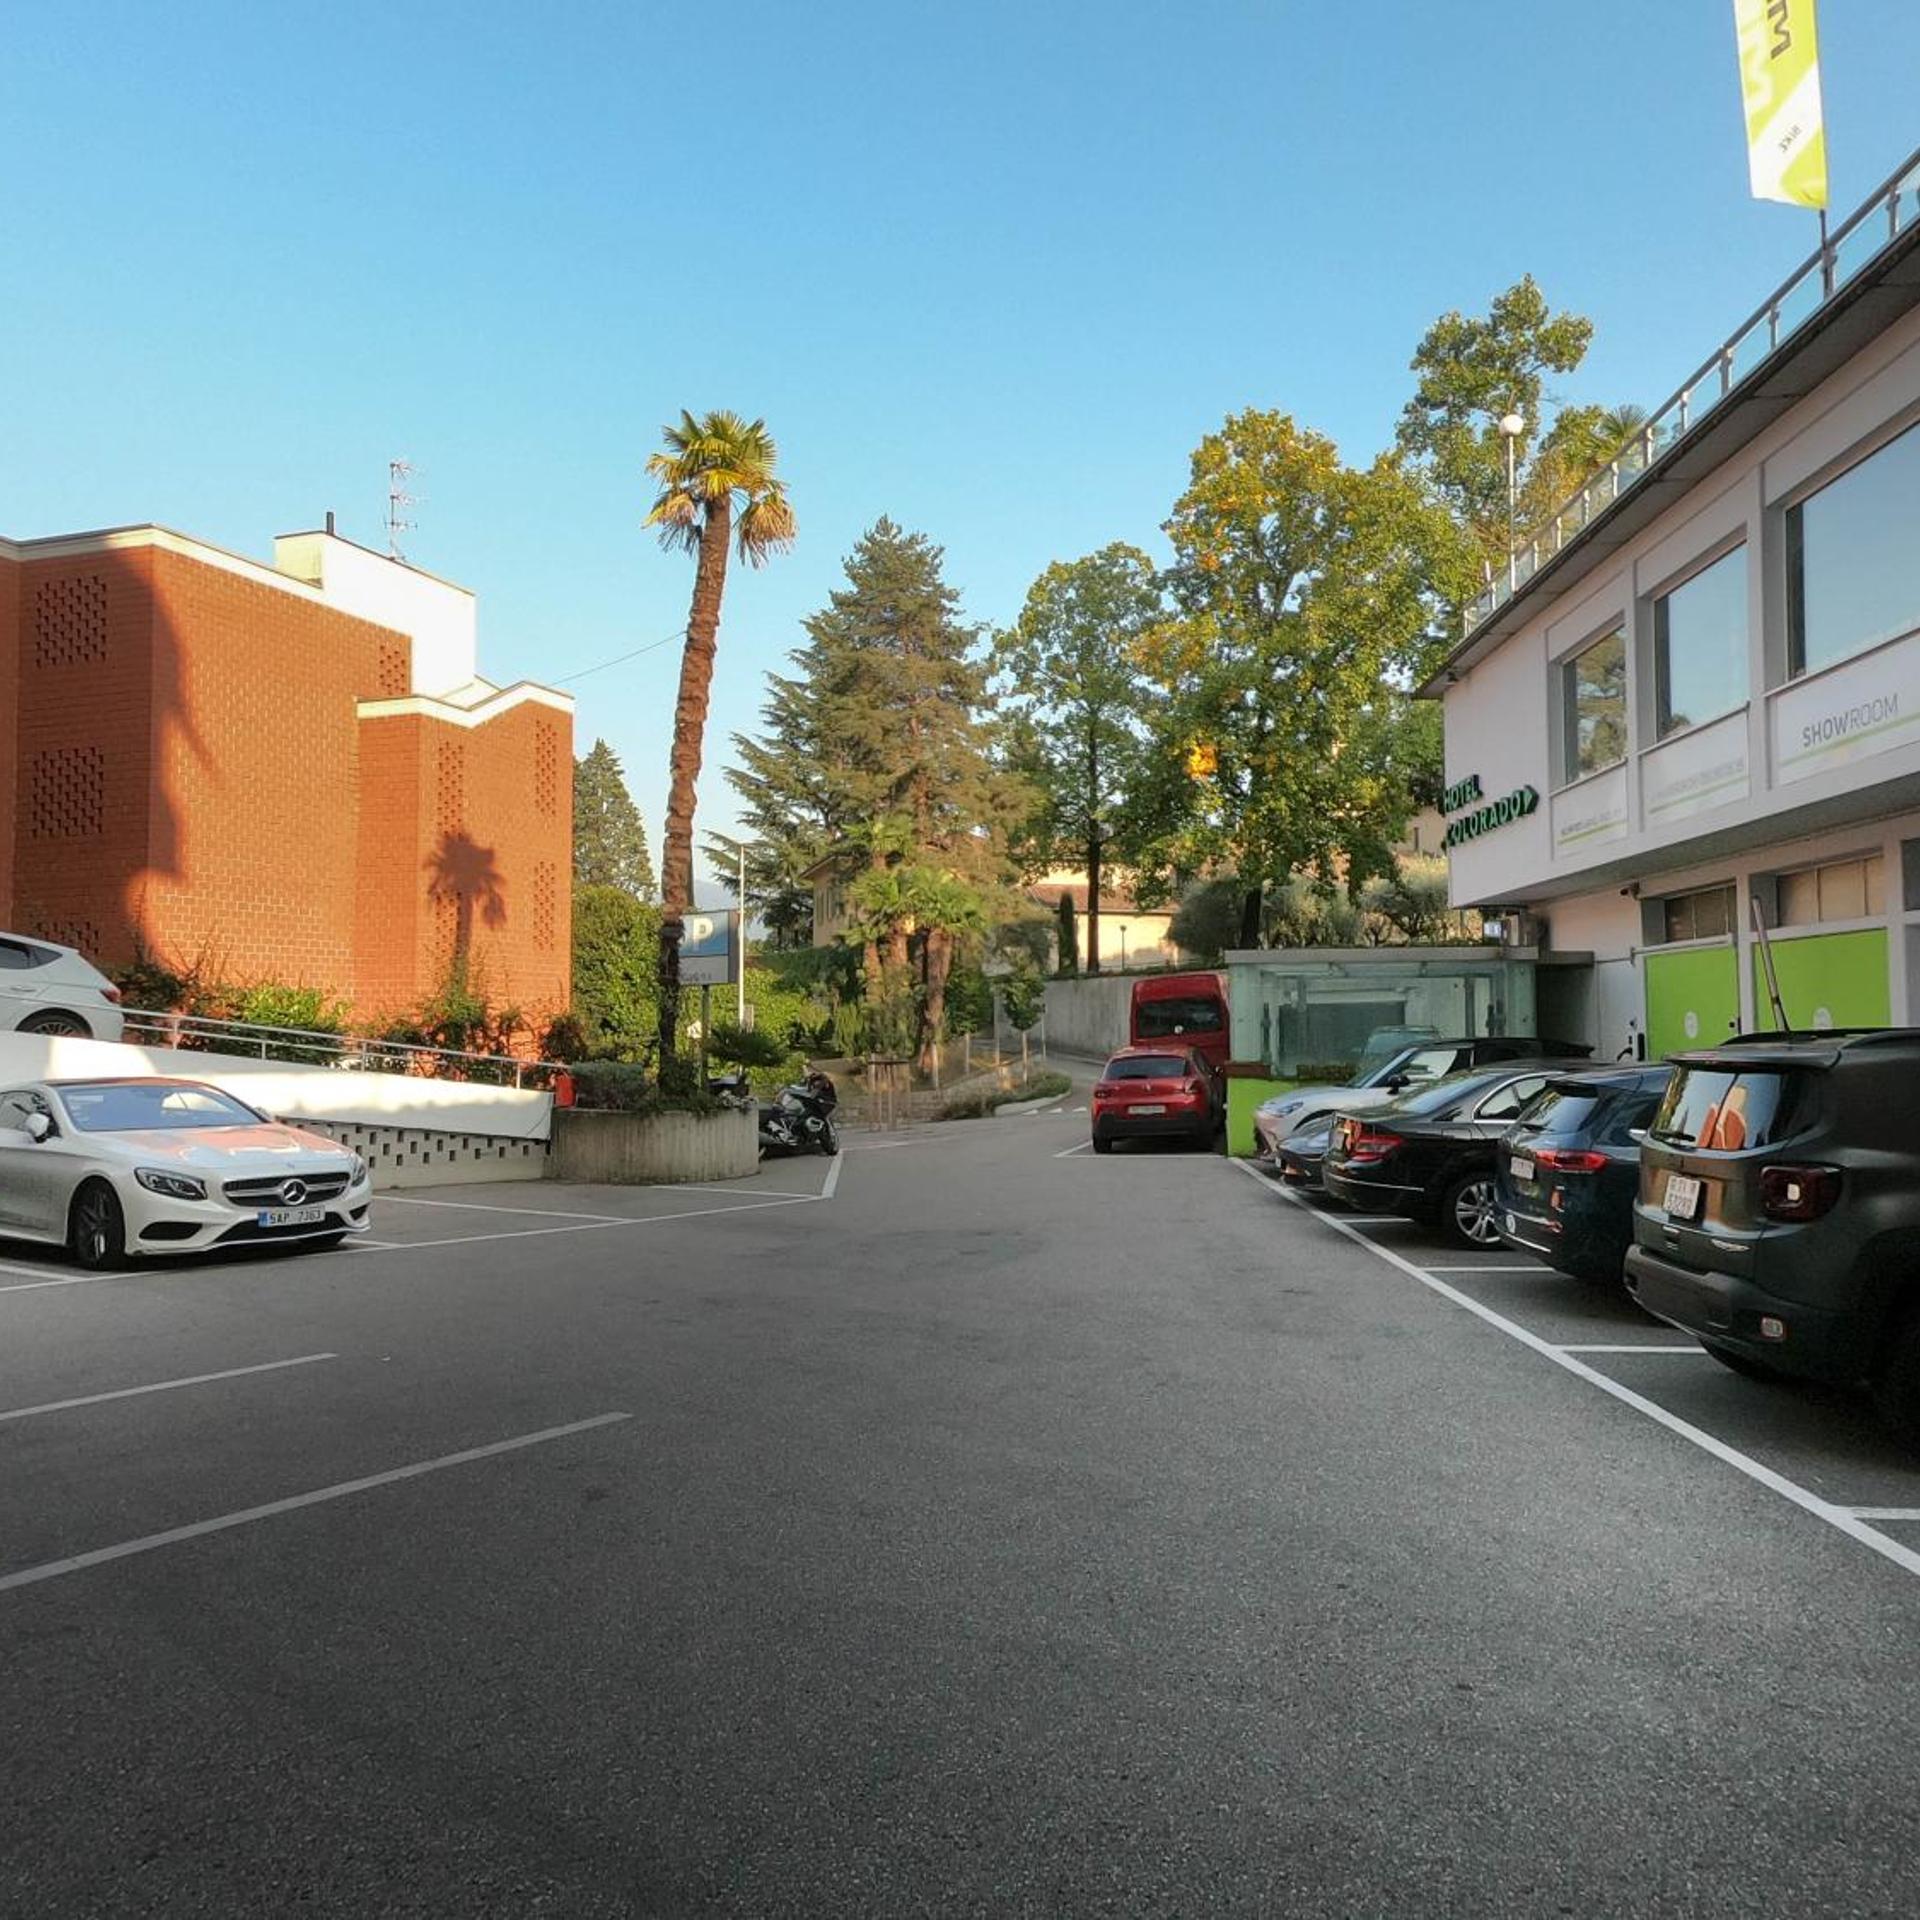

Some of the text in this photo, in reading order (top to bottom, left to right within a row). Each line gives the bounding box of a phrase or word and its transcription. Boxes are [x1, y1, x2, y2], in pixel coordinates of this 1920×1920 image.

[1802, 693, 1898, 748] SHOWROOM
[1443, 775, 1482, 813] HOTEL
[1447, 789, 1523, 847] COLORADO
[692, 917, 714, 950] P
